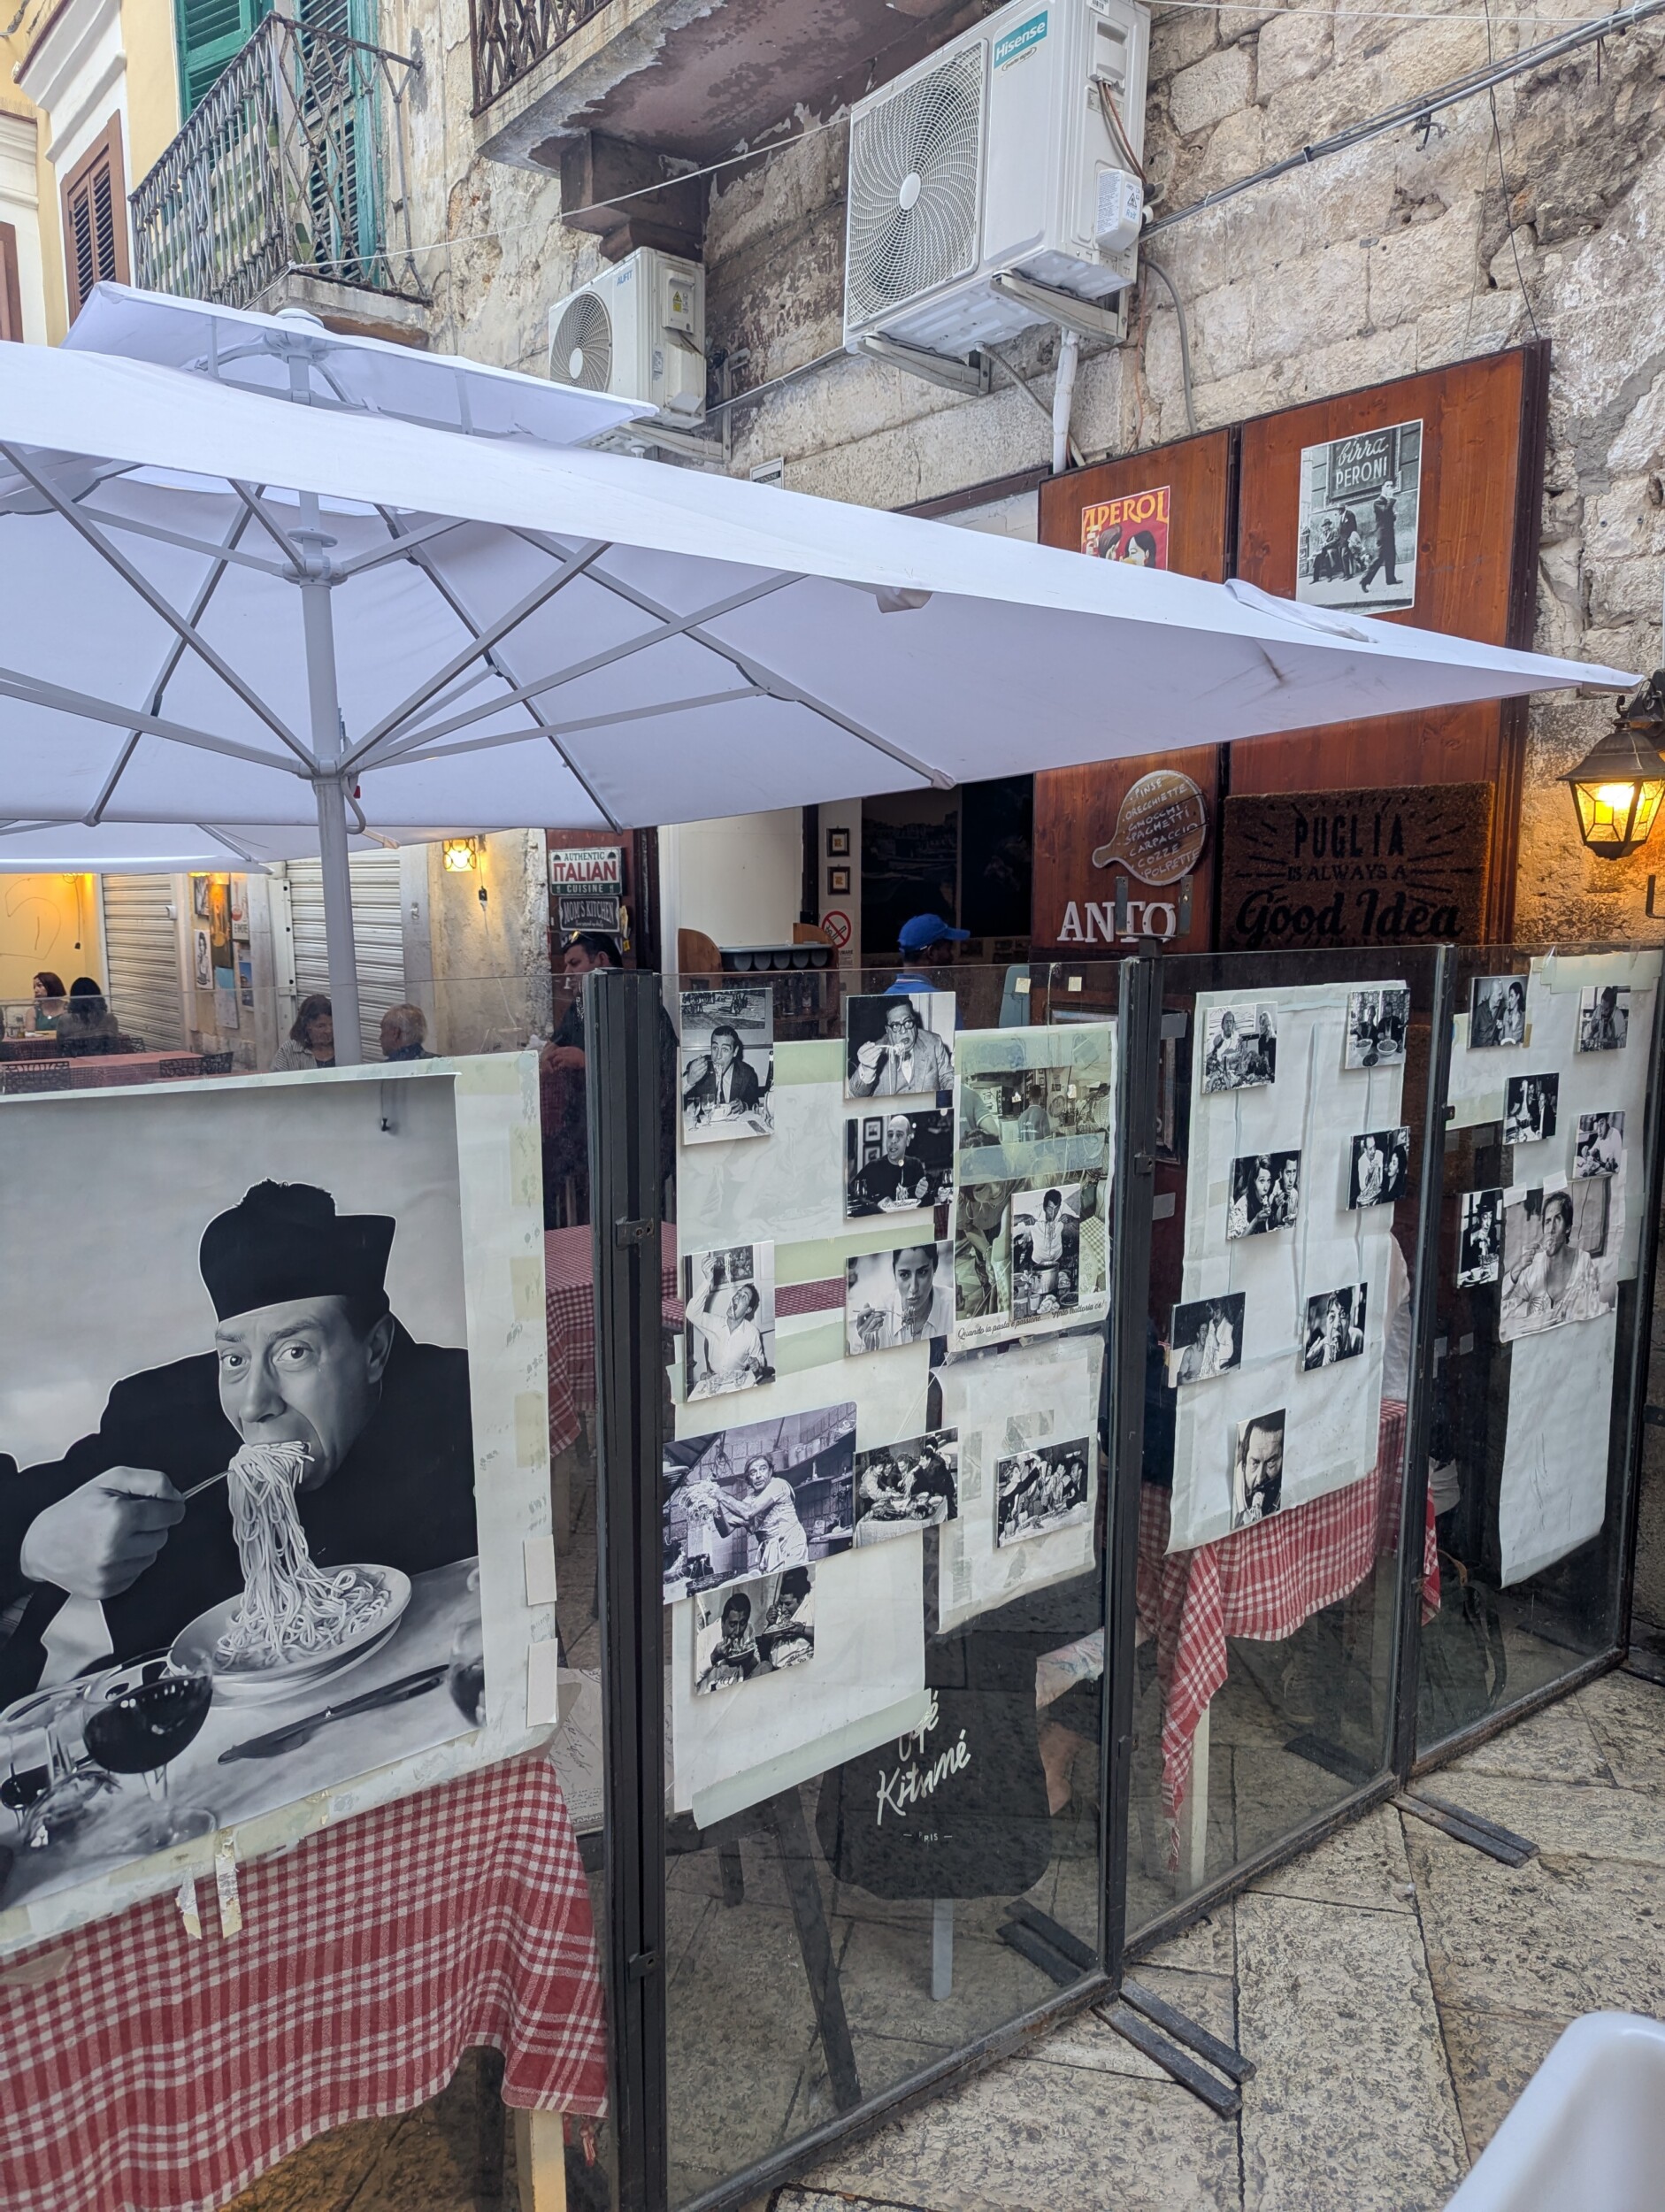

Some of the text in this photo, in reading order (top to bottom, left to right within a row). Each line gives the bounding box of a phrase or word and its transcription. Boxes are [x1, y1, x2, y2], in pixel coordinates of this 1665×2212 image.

[995, 21, 1046, 61] Hisense
[1336, 436, 1389, 466] birra
[1336, 456, 1387, 489] PERONI
[1083, 490, 1169, 543] APEROL
[1125, 783, 1187, 820] ORECCHIETTE
[1135, 777, 1162, 799] PINSE
[1124, 806, 1190, 846] SPAGHETTI
[1128, 802, 1182, 833] GNOCCHI
[1129, 823, 1199, 857] CARPACCIO
[1293, 811, 1405, 858] PUGLIA
[564, 852, 605, 861] AUTHENTIC
[1138, 843, 1180, 869] COZZE
[1144, 848, 1201, 879] POLPETTE
[553, 861, 617, 882] ITALIAN
[1287, 864, 1408, 881] IS ALWAYS A
[567, 884, 603, 894] CUISINE
[564, 900, 615, 925] MOM'S KITCHEN
[1236, 887, 1464, 948] Good Idea
[957, 1326, 985, 1340] Quando
[992, 1321, 1009, 1334] pasta
[918, 1831, 939, 1842] PRIS
